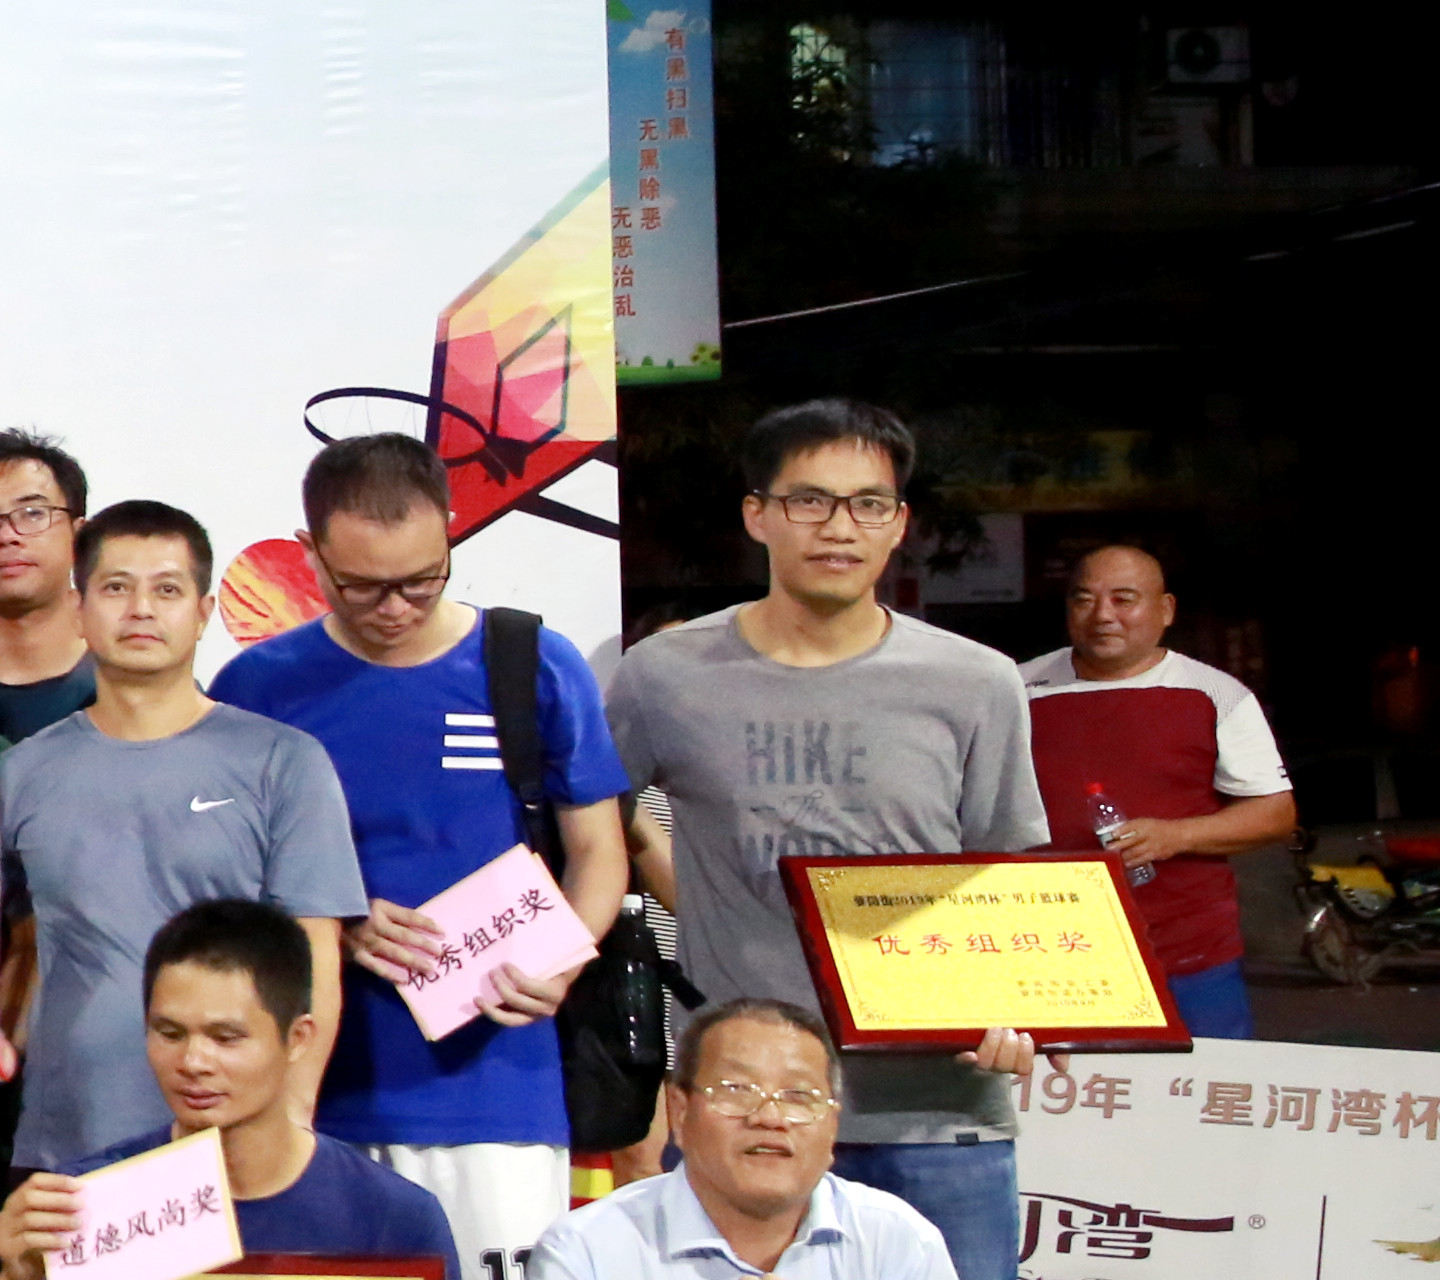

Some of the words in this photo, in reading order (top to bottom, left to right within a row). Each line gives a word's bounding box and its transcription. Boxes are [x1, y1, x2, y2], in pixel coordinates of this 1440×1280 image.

[637, 119, 663, 231] 无黑除恶
[611, 206, 636, 318] 无恶治乱
[872, 930, 1093, 957] 优秀组织奖
[58, 1182, 223, 1271] 道德风尚奖
